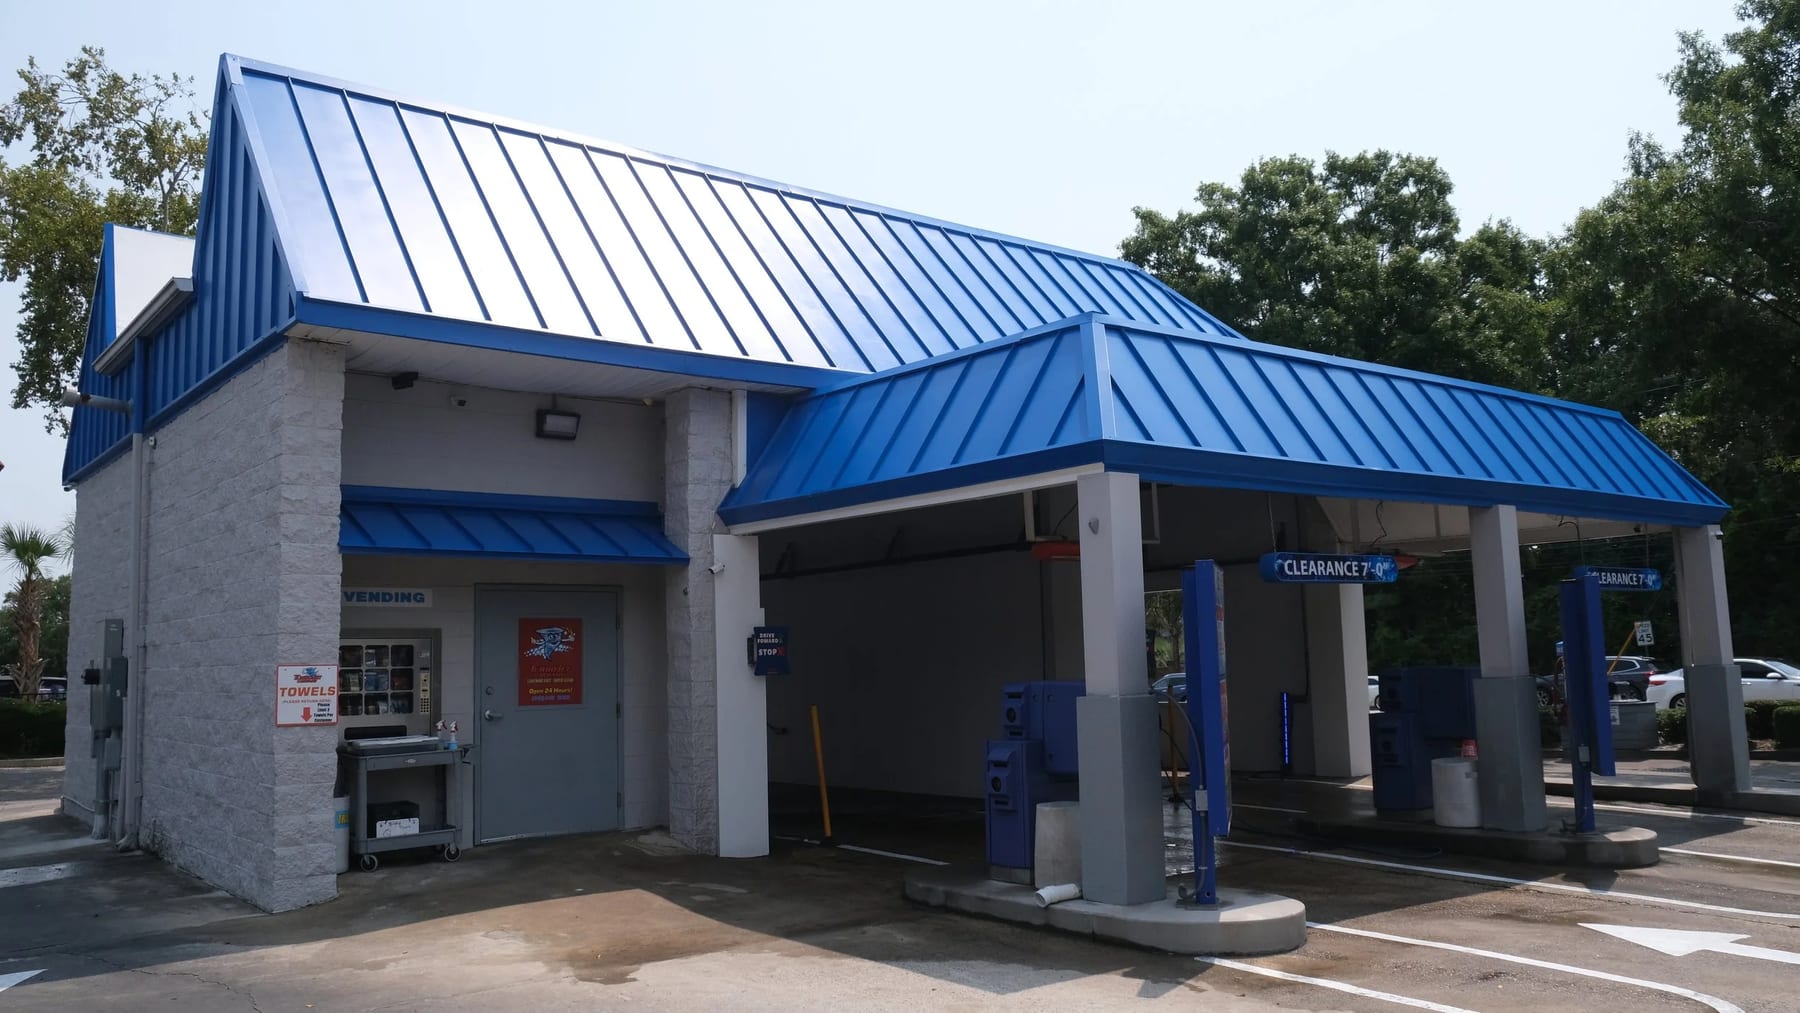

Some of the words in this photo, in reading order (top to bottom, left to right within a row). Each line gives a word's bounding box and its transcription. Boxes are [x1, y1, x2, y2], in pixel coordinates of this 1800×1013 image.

[1284, 560, 1359, 576] CLEARANCE
[1361, 561, 1388, 577] 7'-0"
[343, 591, 425, 603] VENDING
[1639, 633, 1653, 642] 45
[758, 648, 777, 656] STOP
[279, 686, 336, 697] TOWELS
